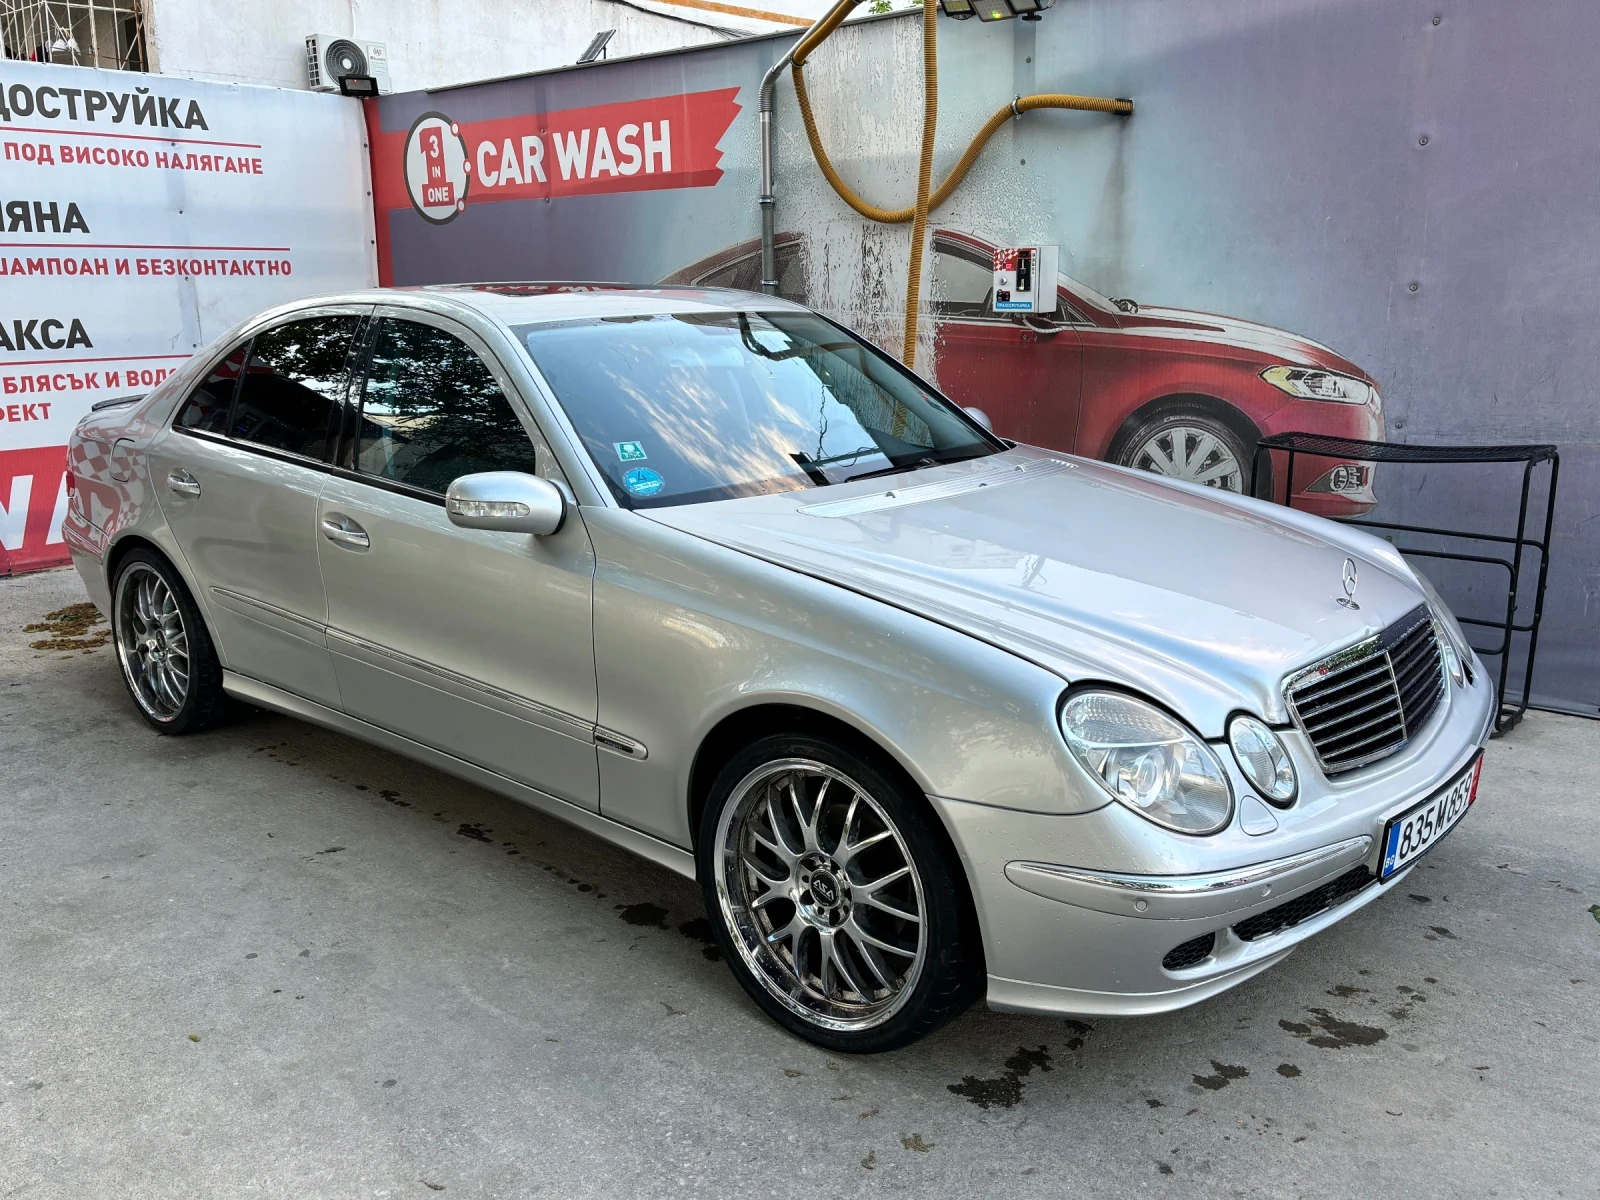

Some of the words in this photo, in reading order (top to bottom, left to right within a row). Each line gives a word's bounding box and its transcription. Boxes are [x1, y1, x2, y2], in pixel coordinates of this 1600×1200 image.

[4, 142, 55, 165] ПОД
[60, 145, 149, 168] ВИСОКО
[155, 152, 264, 174] НАЛЯГАНЕ
[429, 135, 439, 158] 3
[477, 135, 548, 188] CAR
[552, 119, 672, 181] WASH
[432, 165, 441, 178] IN
[427, 186, 450, 203] ONE
[0, 200, 91, 233] ЯНА
[115, 258, 130, 275] И
[136, 259, 292, 276] БЕЗКОНТАКТНО
[2, 371, 100, 394] БЛЯСЪК
[105, 371, 120, 388] И
[0, 402, 52, 422] ЕКТ
